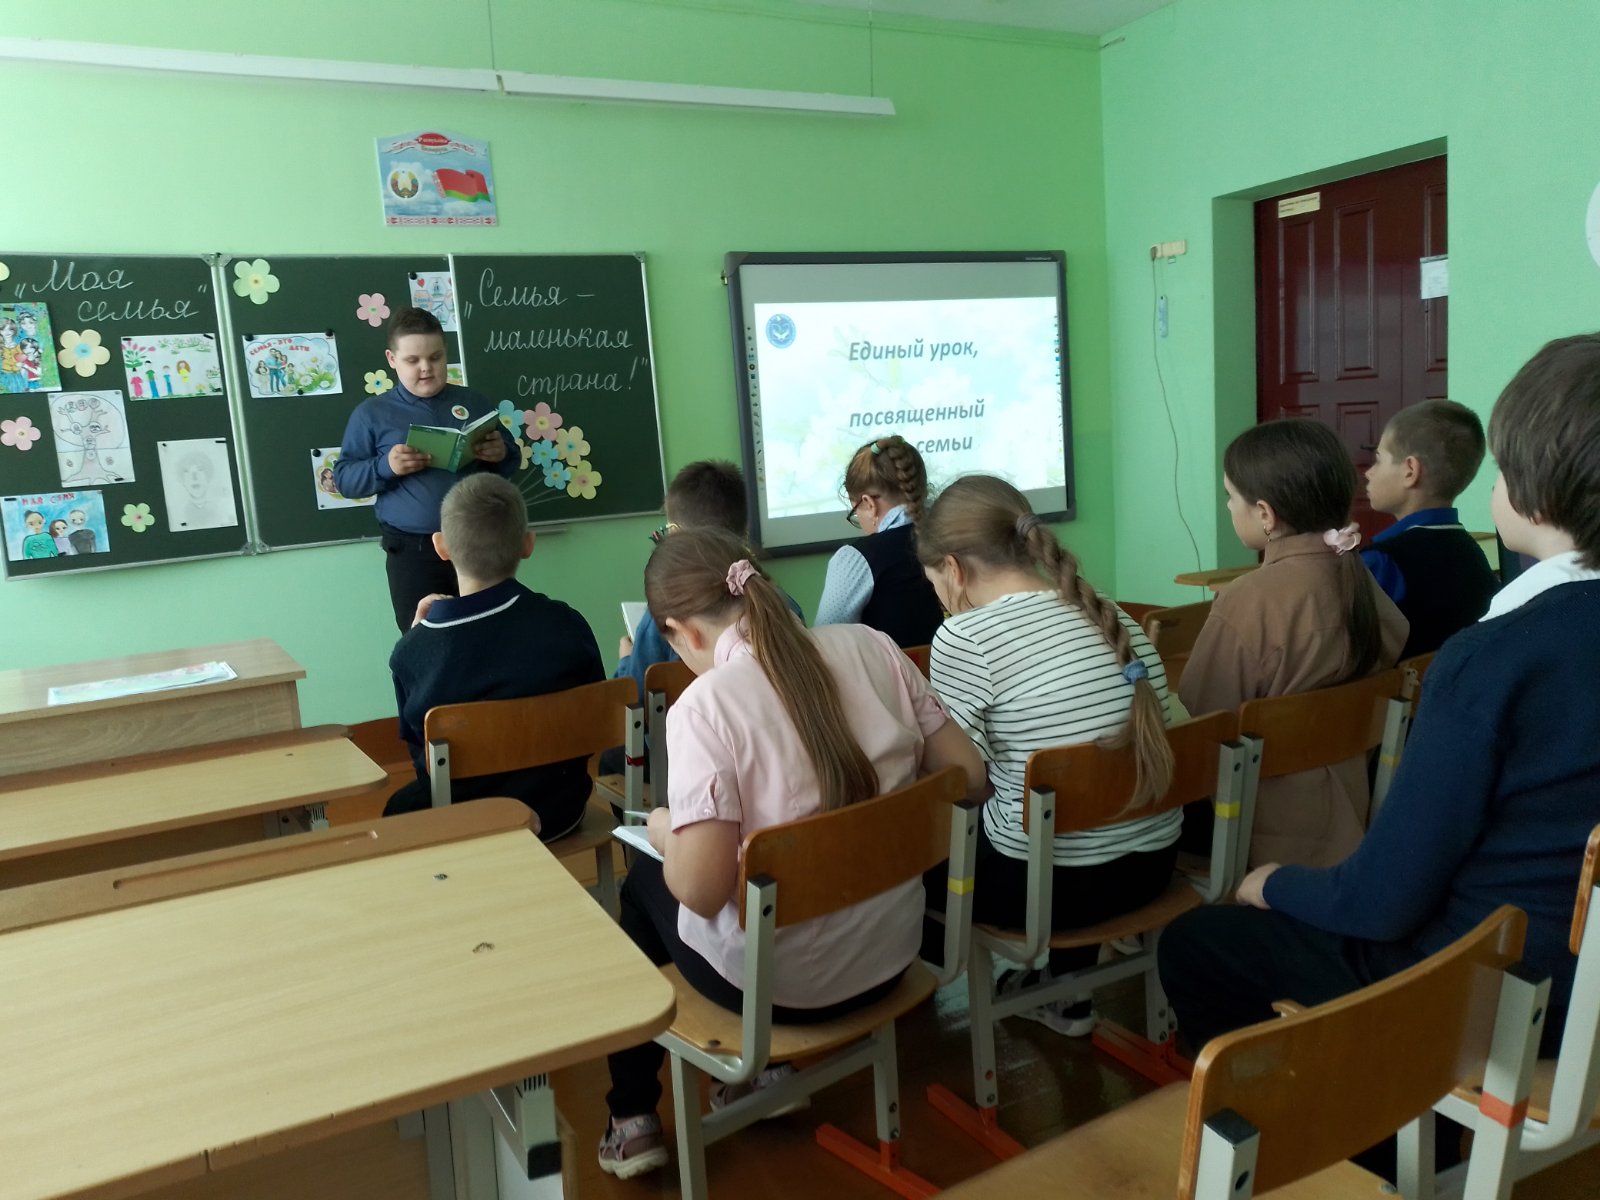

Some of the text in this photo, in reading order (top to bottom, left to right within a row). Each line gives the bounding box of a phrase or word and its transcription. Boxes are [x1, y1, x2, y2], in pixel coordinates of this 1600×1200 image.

[484, 327, 635, 353] маленькая
[848, 338, 979, 362] Единый урок,
[849, 398, 985, 427] посвященный
[916, 435, 973, 455] семьи
